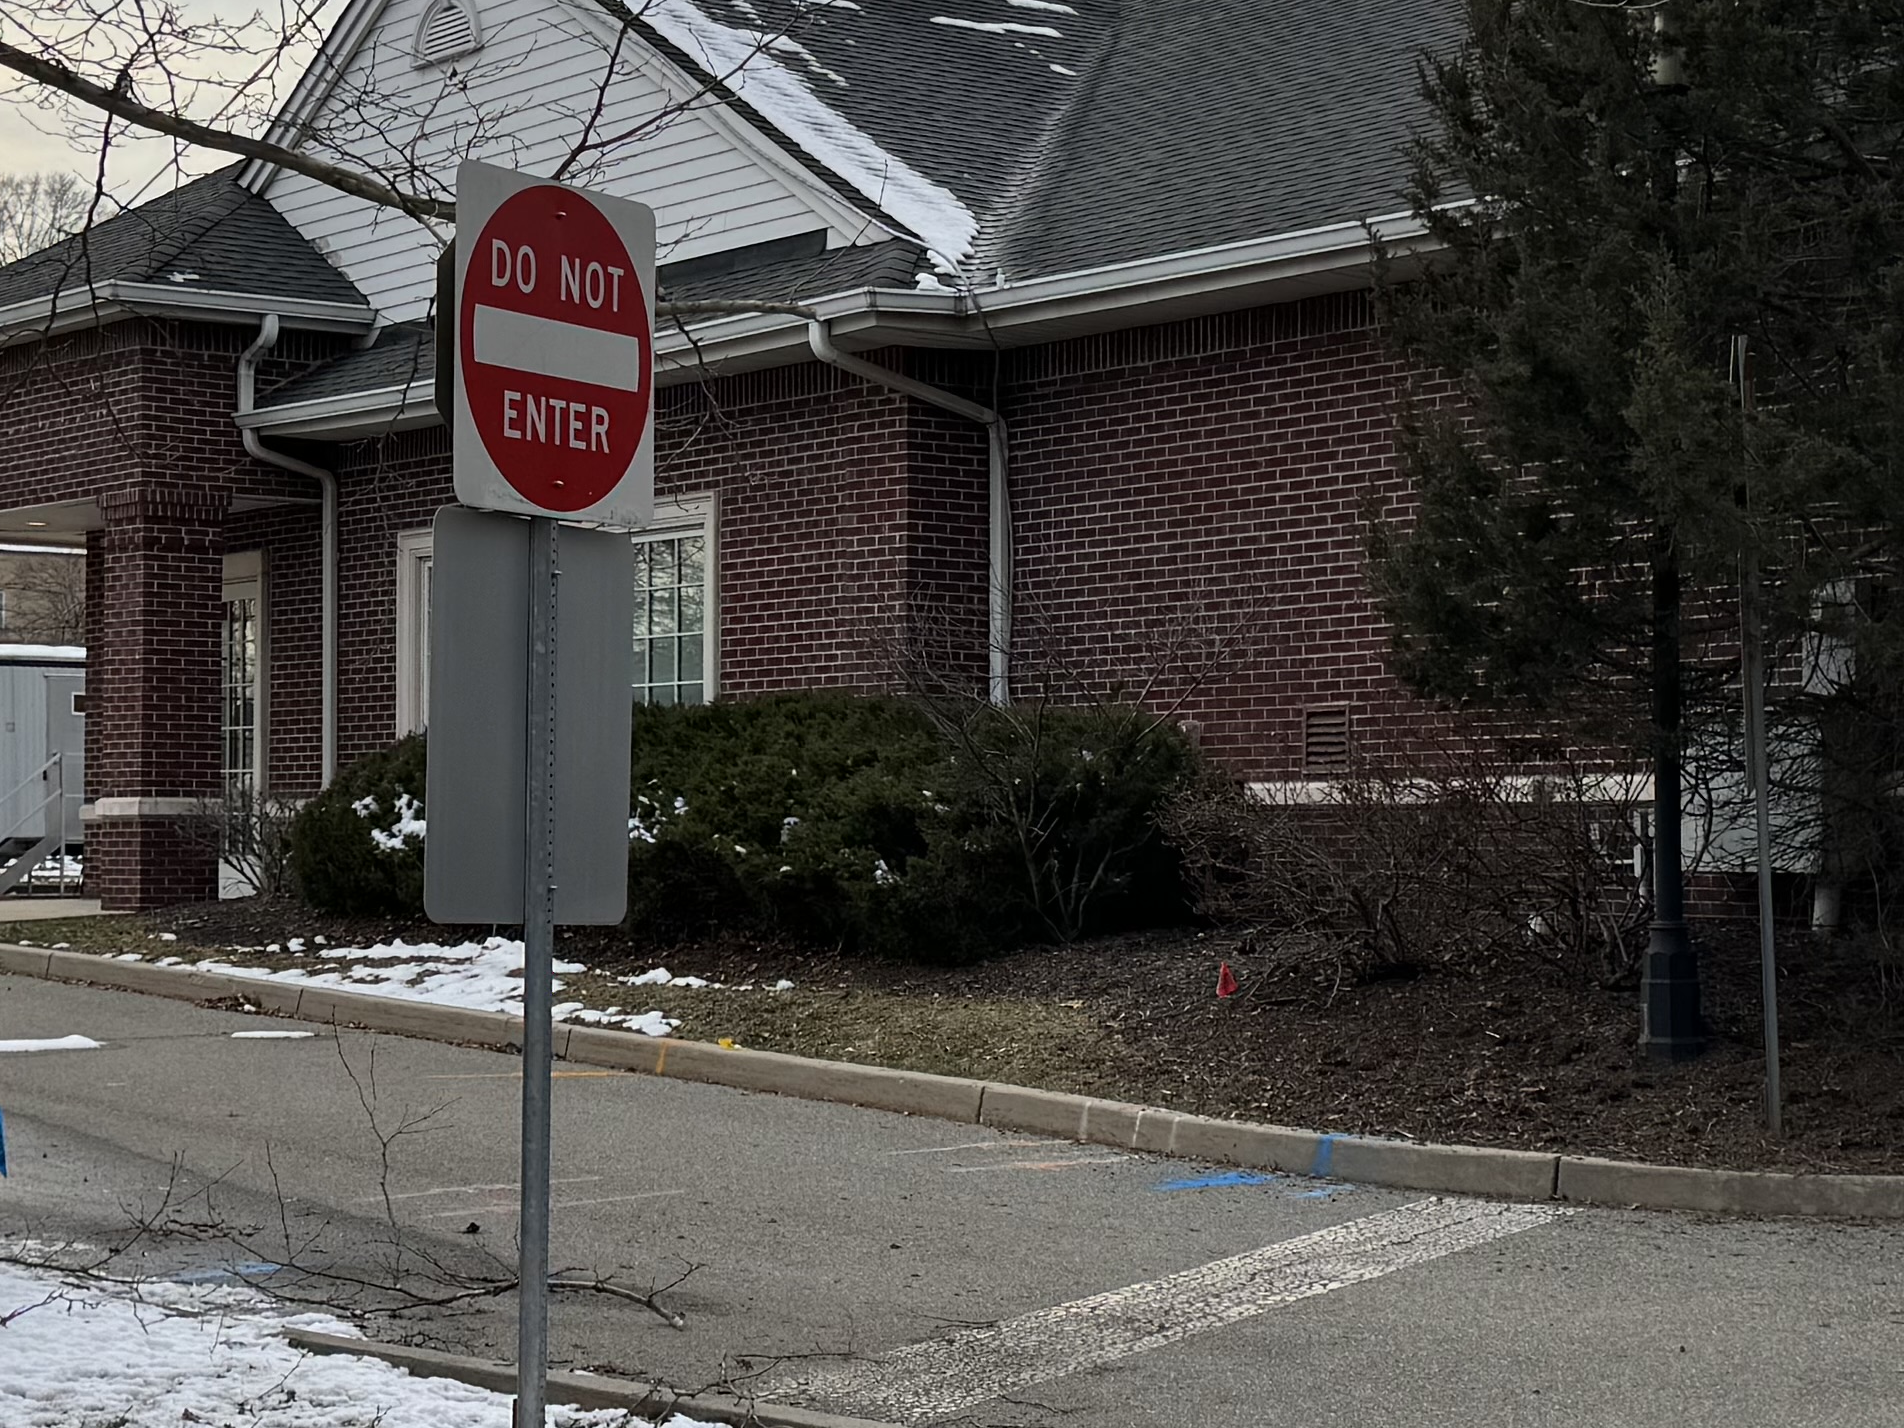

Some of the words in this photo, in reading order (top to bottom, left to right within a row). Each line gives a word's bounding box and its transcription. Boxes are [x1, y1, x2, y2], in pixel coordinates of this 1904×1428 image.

[491, 238, 537, 294] DO
[560, 255, 624, 312] NOT
[503, 390, 610, 454] ENTER
